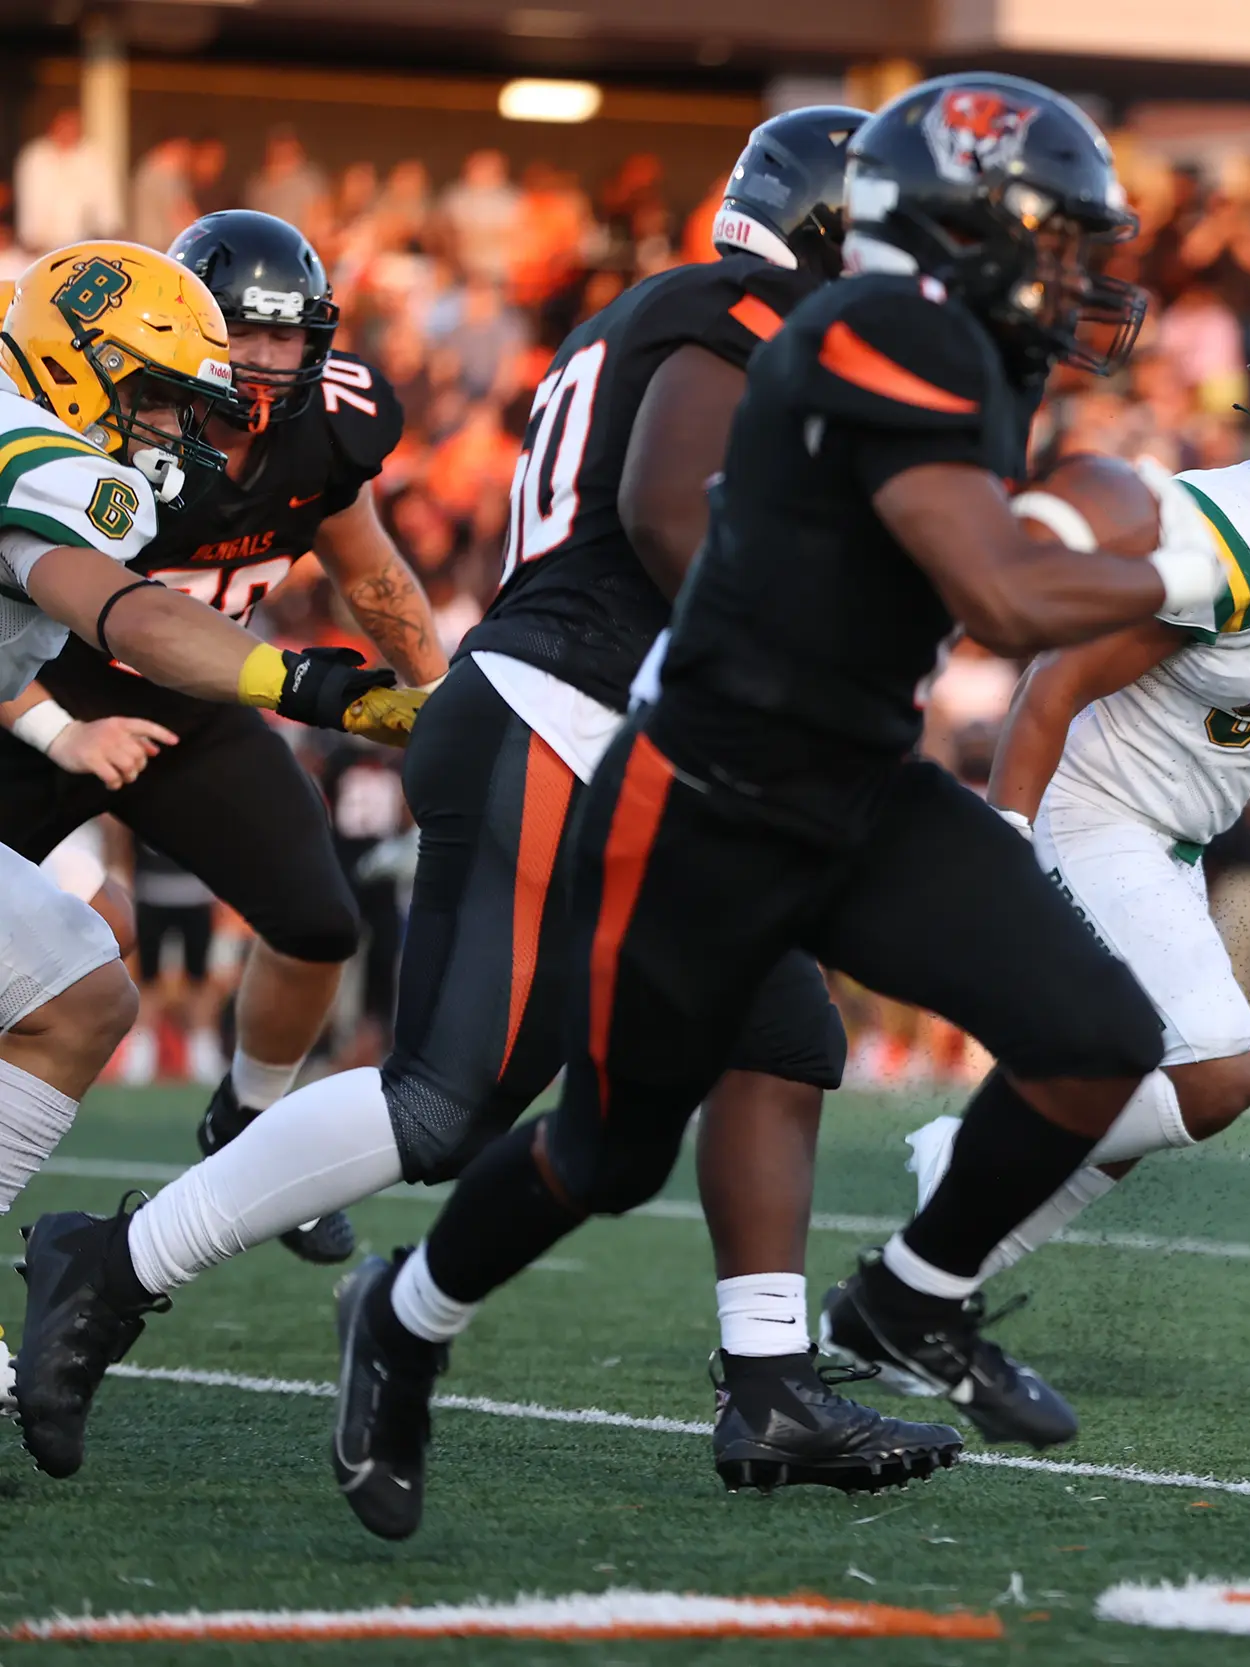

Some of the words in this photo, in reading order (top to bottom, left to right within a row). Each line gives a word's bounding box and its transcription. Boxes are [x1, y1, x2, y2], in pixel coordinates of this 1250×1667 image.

[321, 357, 377, 417] 70
[85, 478, 139, 540] 6
[190, 530, 276, 562] BENGALS
